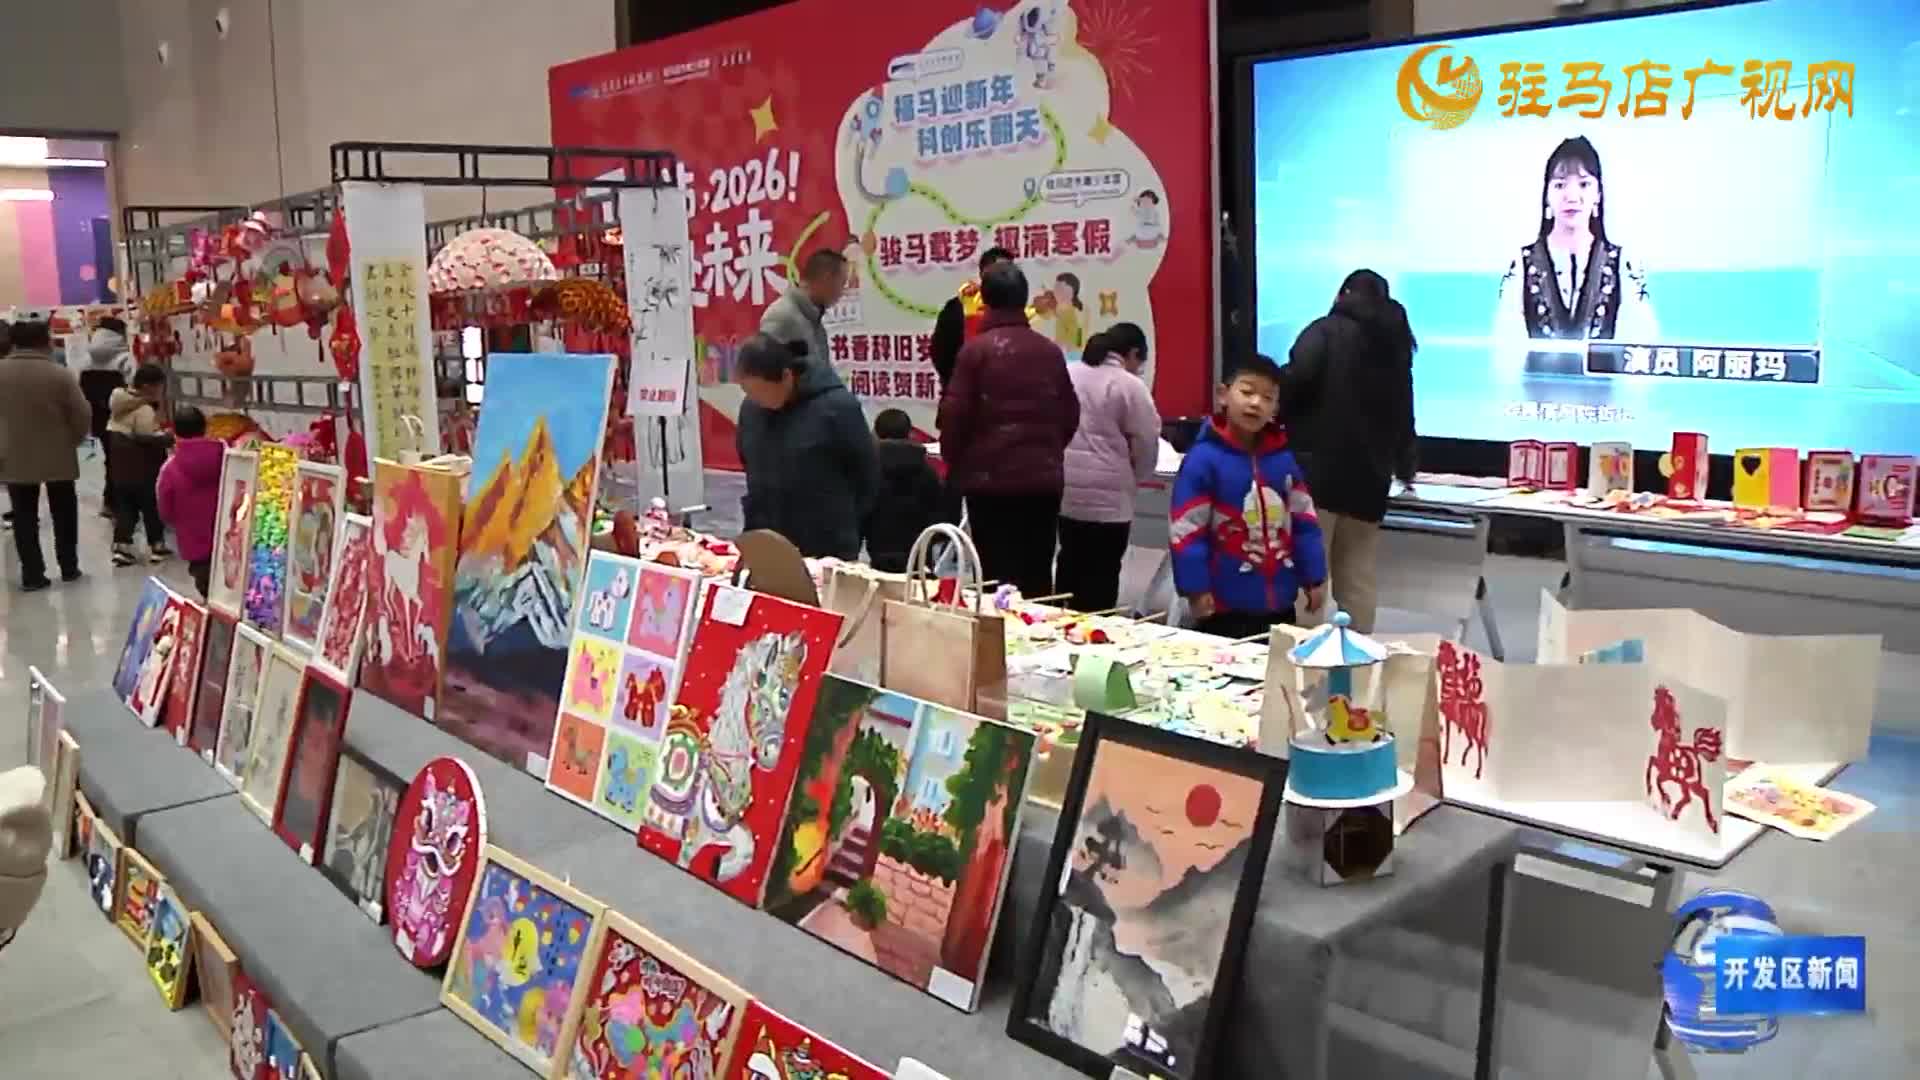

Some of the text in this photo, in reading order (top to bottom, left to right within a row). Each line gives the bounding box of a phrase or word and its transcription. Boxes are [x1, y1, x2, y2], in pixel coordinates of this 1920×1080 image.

[918, 108, 1040, 157] 科创乐翻天
[880, 228, 979, 267] 骏马载梦
[1624, 345, 1786, 380] 演员 阿丽玛
[851, 369, 943, 400] 阅读贺新
